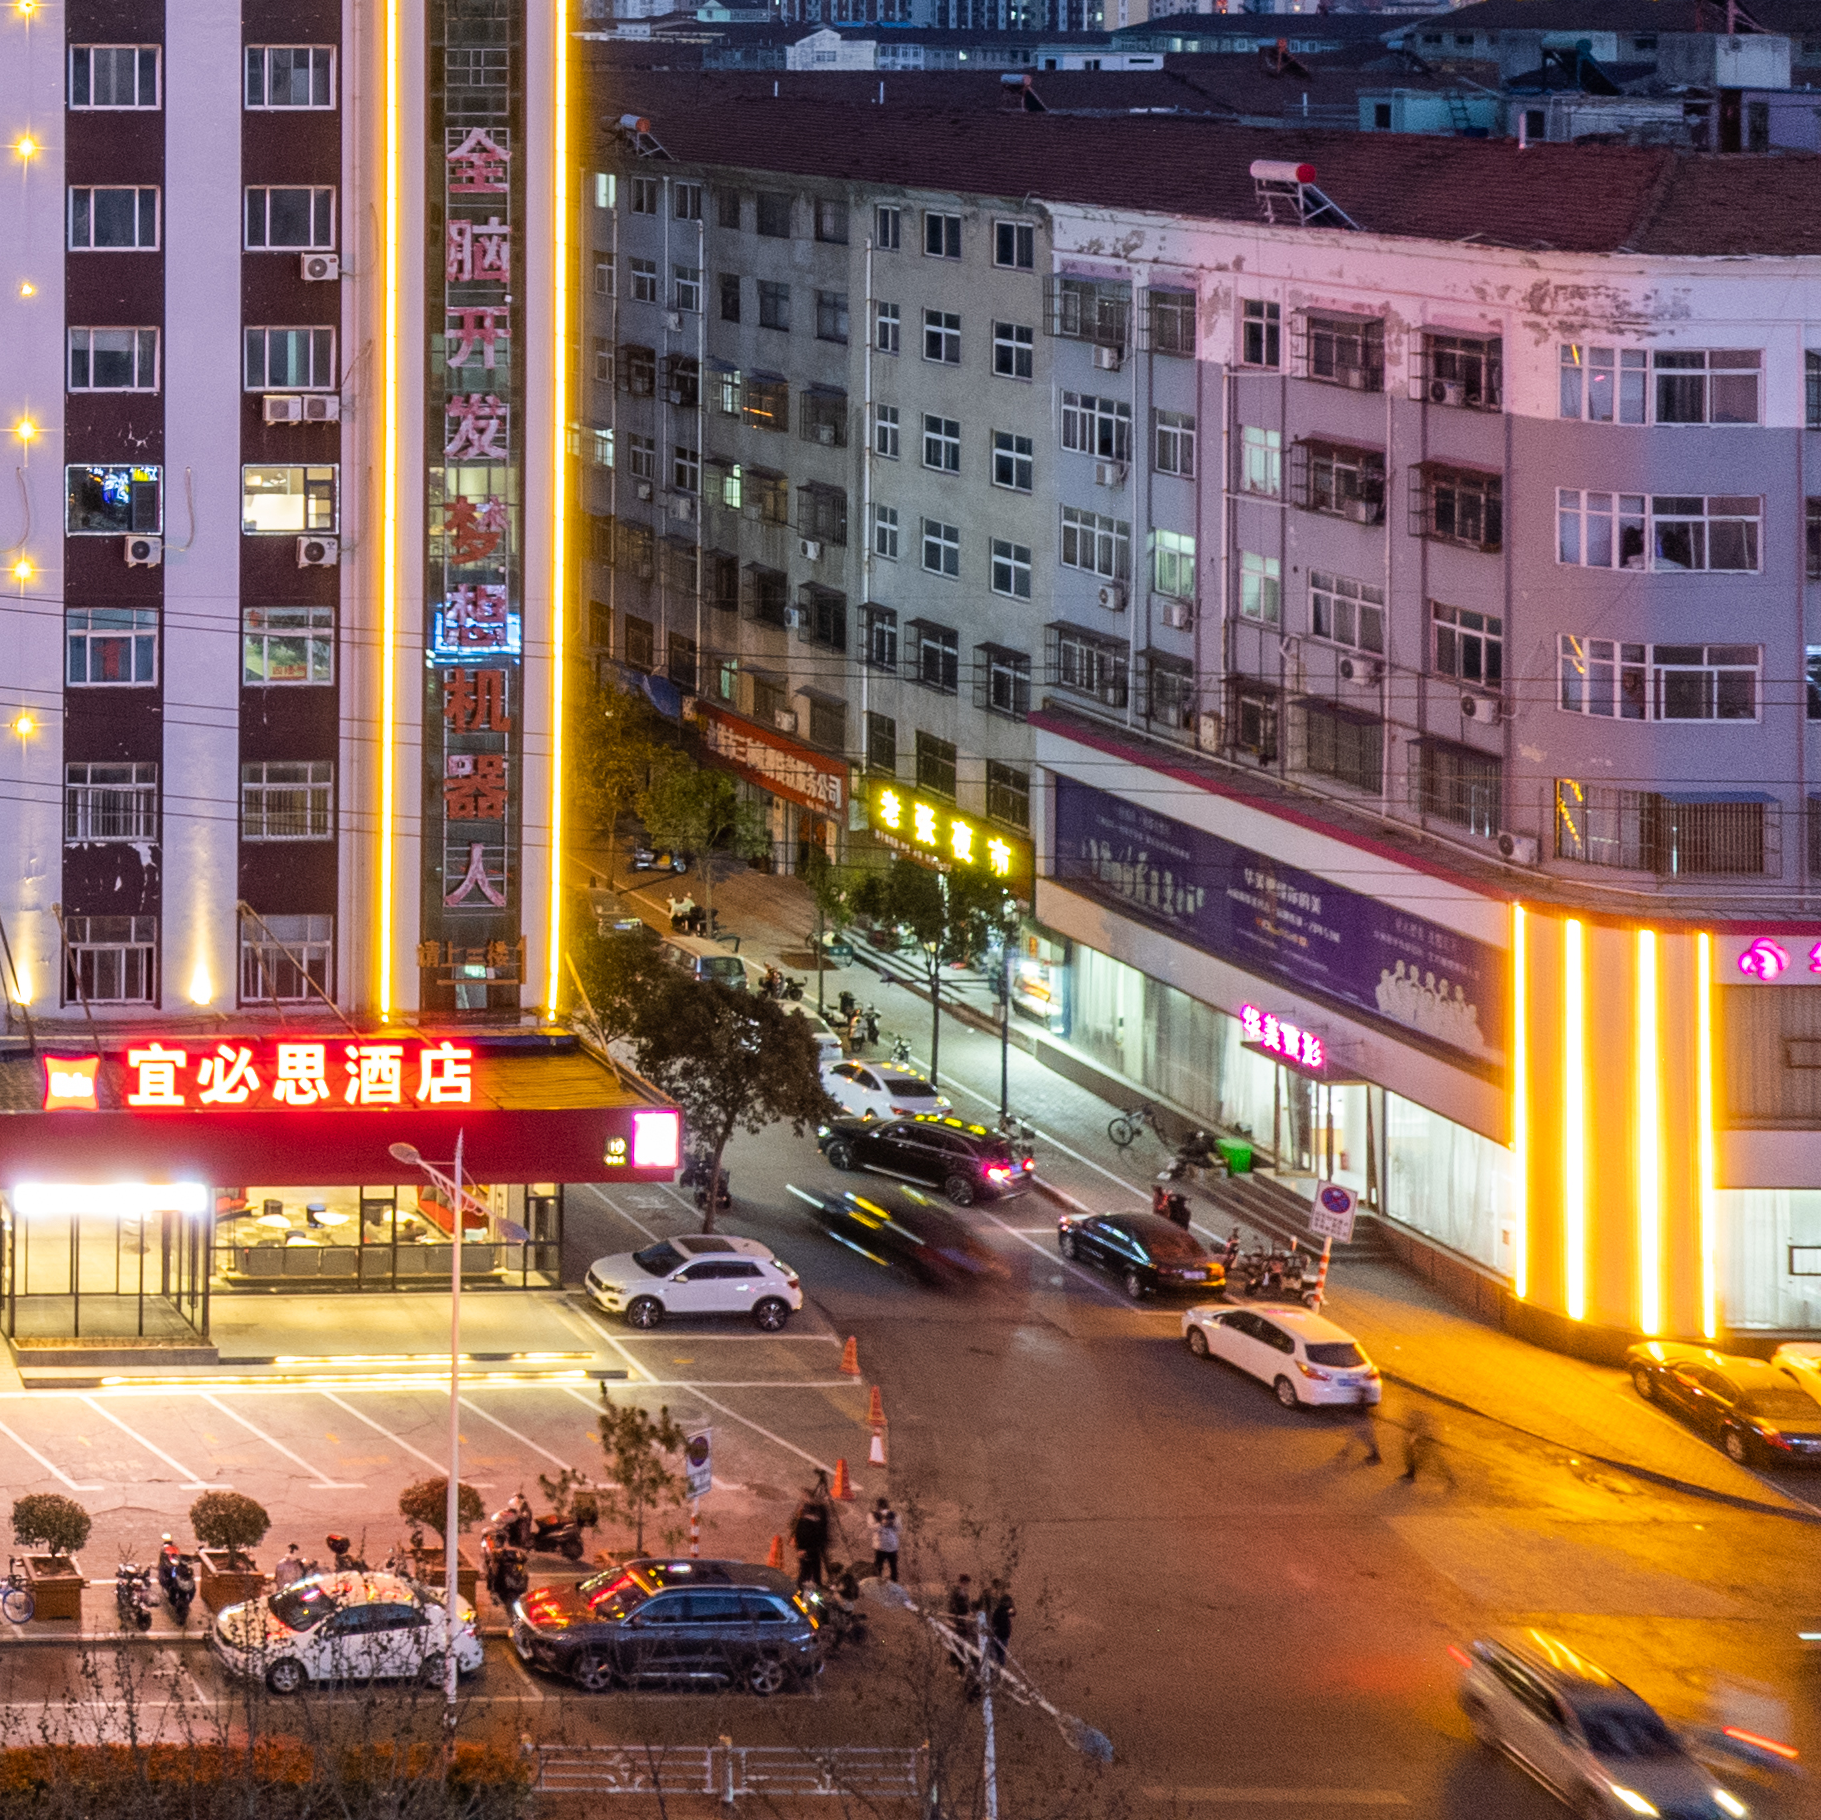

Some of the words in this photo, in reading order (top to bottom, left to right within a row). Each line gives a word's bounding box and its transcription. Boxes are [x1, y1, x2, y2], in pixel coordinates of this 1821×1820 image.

[127, 1041, 474, 1107] 宜必思酒店
